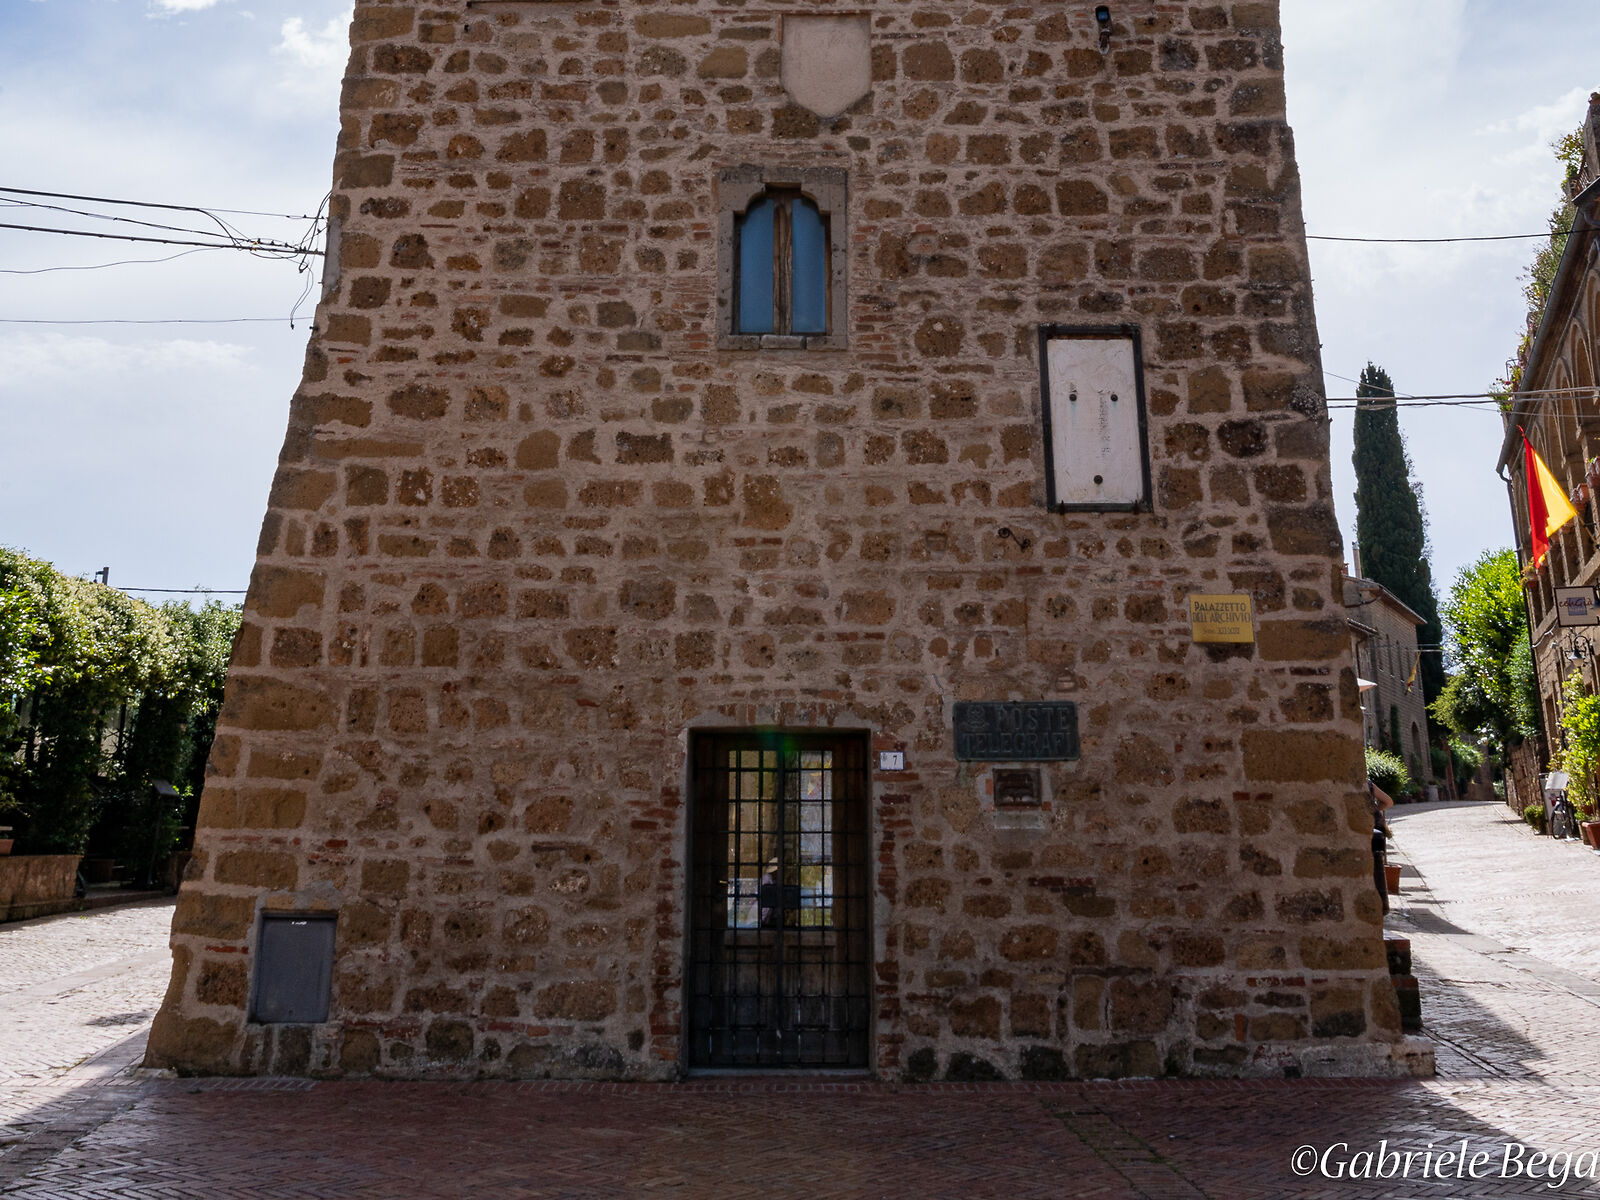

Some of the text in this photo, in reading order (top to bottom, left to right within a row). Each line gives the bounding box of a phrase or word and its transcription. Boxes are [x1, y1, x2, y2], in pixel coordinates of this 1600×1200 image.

[1194, 601, 1247, 612] PALAZZETTO
[995, 705, 1070, 730] POSTE
[962, 732, 1074, 754] TELEGRAFI
[892, 754, 898, 766] 7
